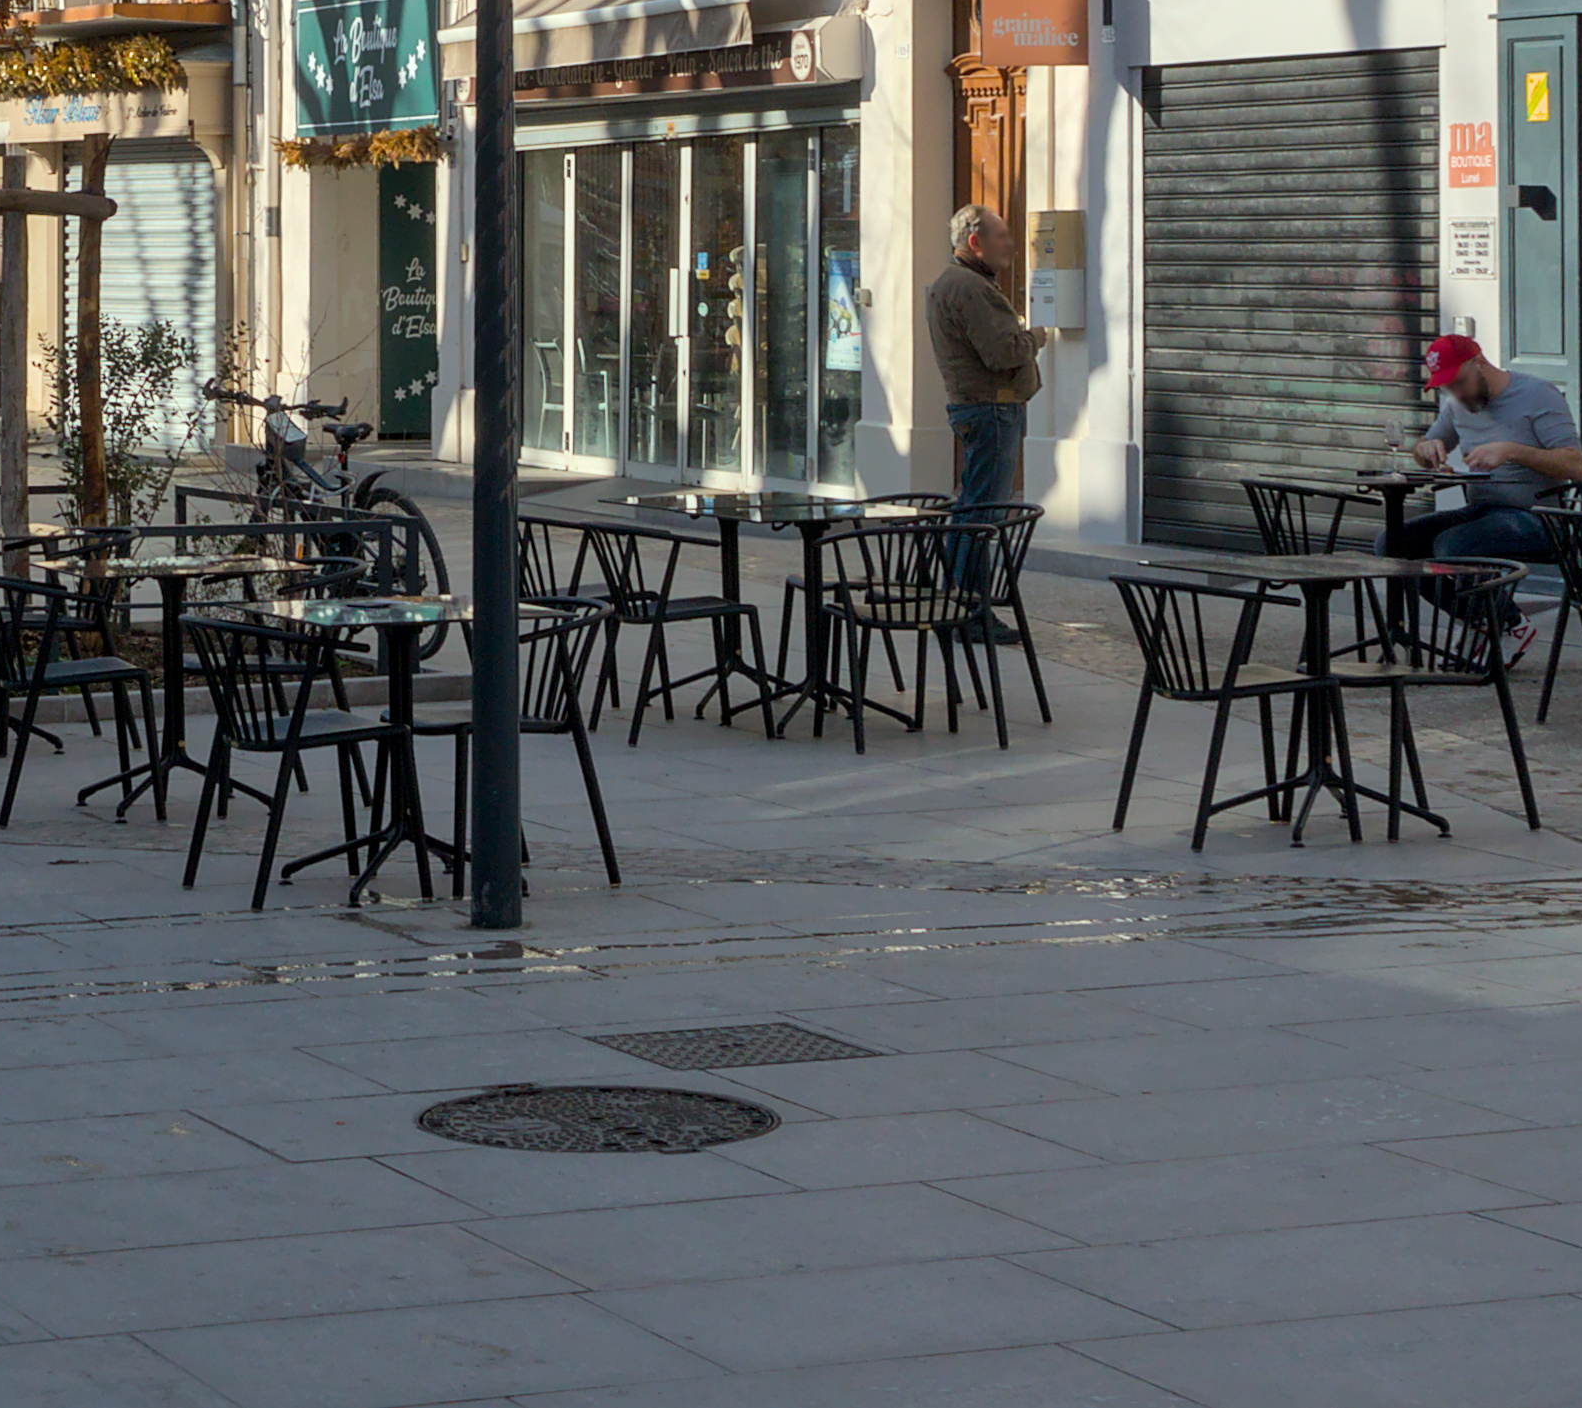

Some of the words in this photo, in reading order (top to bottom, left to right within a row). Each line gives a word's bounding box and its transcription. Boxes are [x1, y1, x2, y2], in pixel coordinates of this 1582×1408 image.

[992, 12, 1042, 38] grain
[1014, 26, 1078, 46] malice
[334, 19, 348, 65] La
[350, 14, 397, 64] Boutique
[614, 59, 655, 88] Glacier
[668, 52, 698, 77] Pain
[709, 47, 744, 76] Salon
[745, 46, 759, 71] de
[761, 41, 783, 70] thé
[794, 54, 809, 69] 1970
[349, 65, 384, 109] d'Elsa
[1448, 121, 1495, 151] ma
[1451, 155, 1492, 168] BOUTIQUE
[1461, 172, 1480, 183] Lunel
[405, 257, 426, 282] La
[392, 314, 437, 338] d'Elsa
